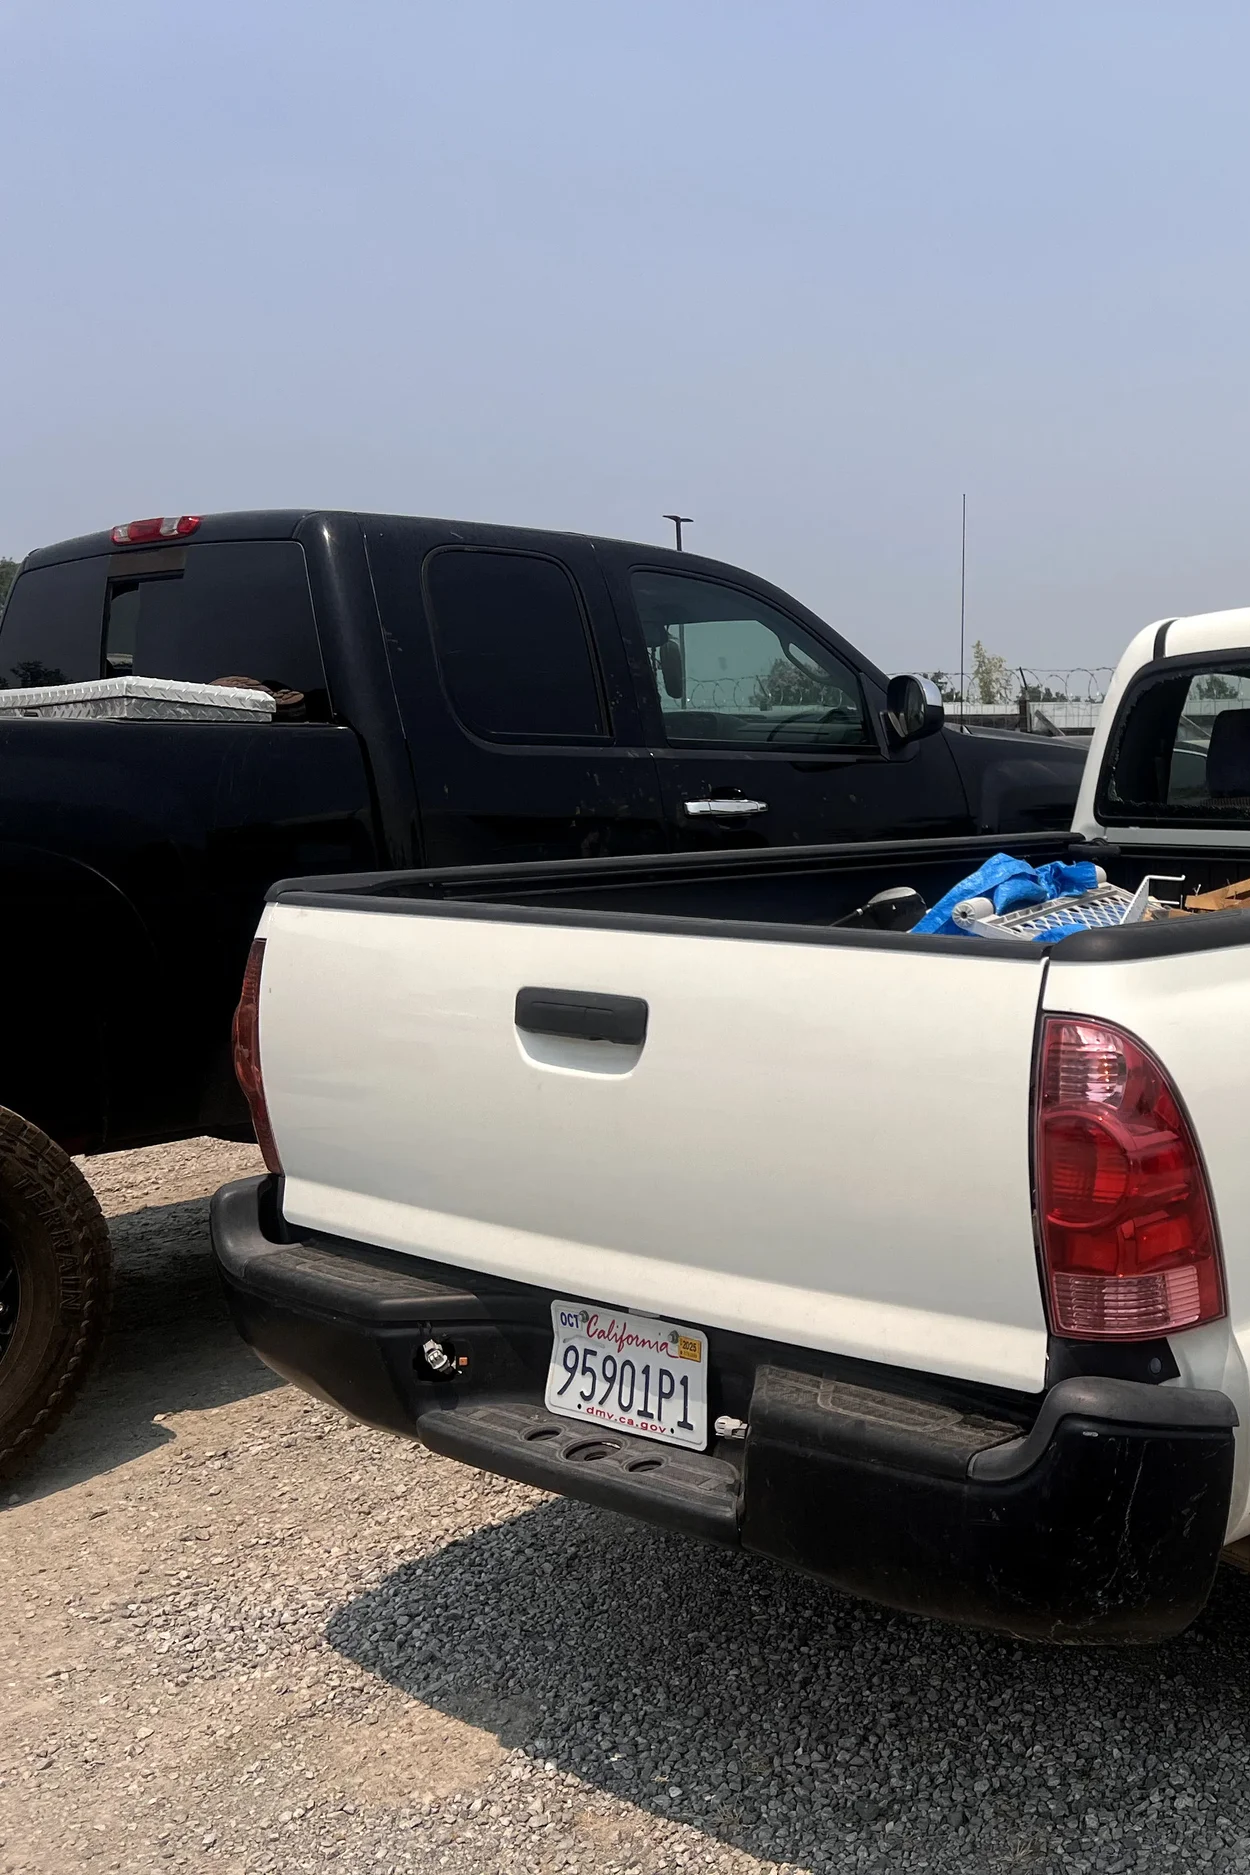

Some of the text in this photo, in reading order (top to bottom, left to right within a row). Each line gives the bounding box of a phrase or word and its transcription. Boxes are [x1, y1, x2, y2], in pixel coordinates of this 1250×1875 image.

[13, 1172, 83, 1312] TERRAIN
[560, 1311, 579, 1329] OCT
[586, 1314, 679, 1358] California
[557, 1345, 694, 1431] 95901P1
[586, 1406, 667, 1433] dmv.ca.gov
